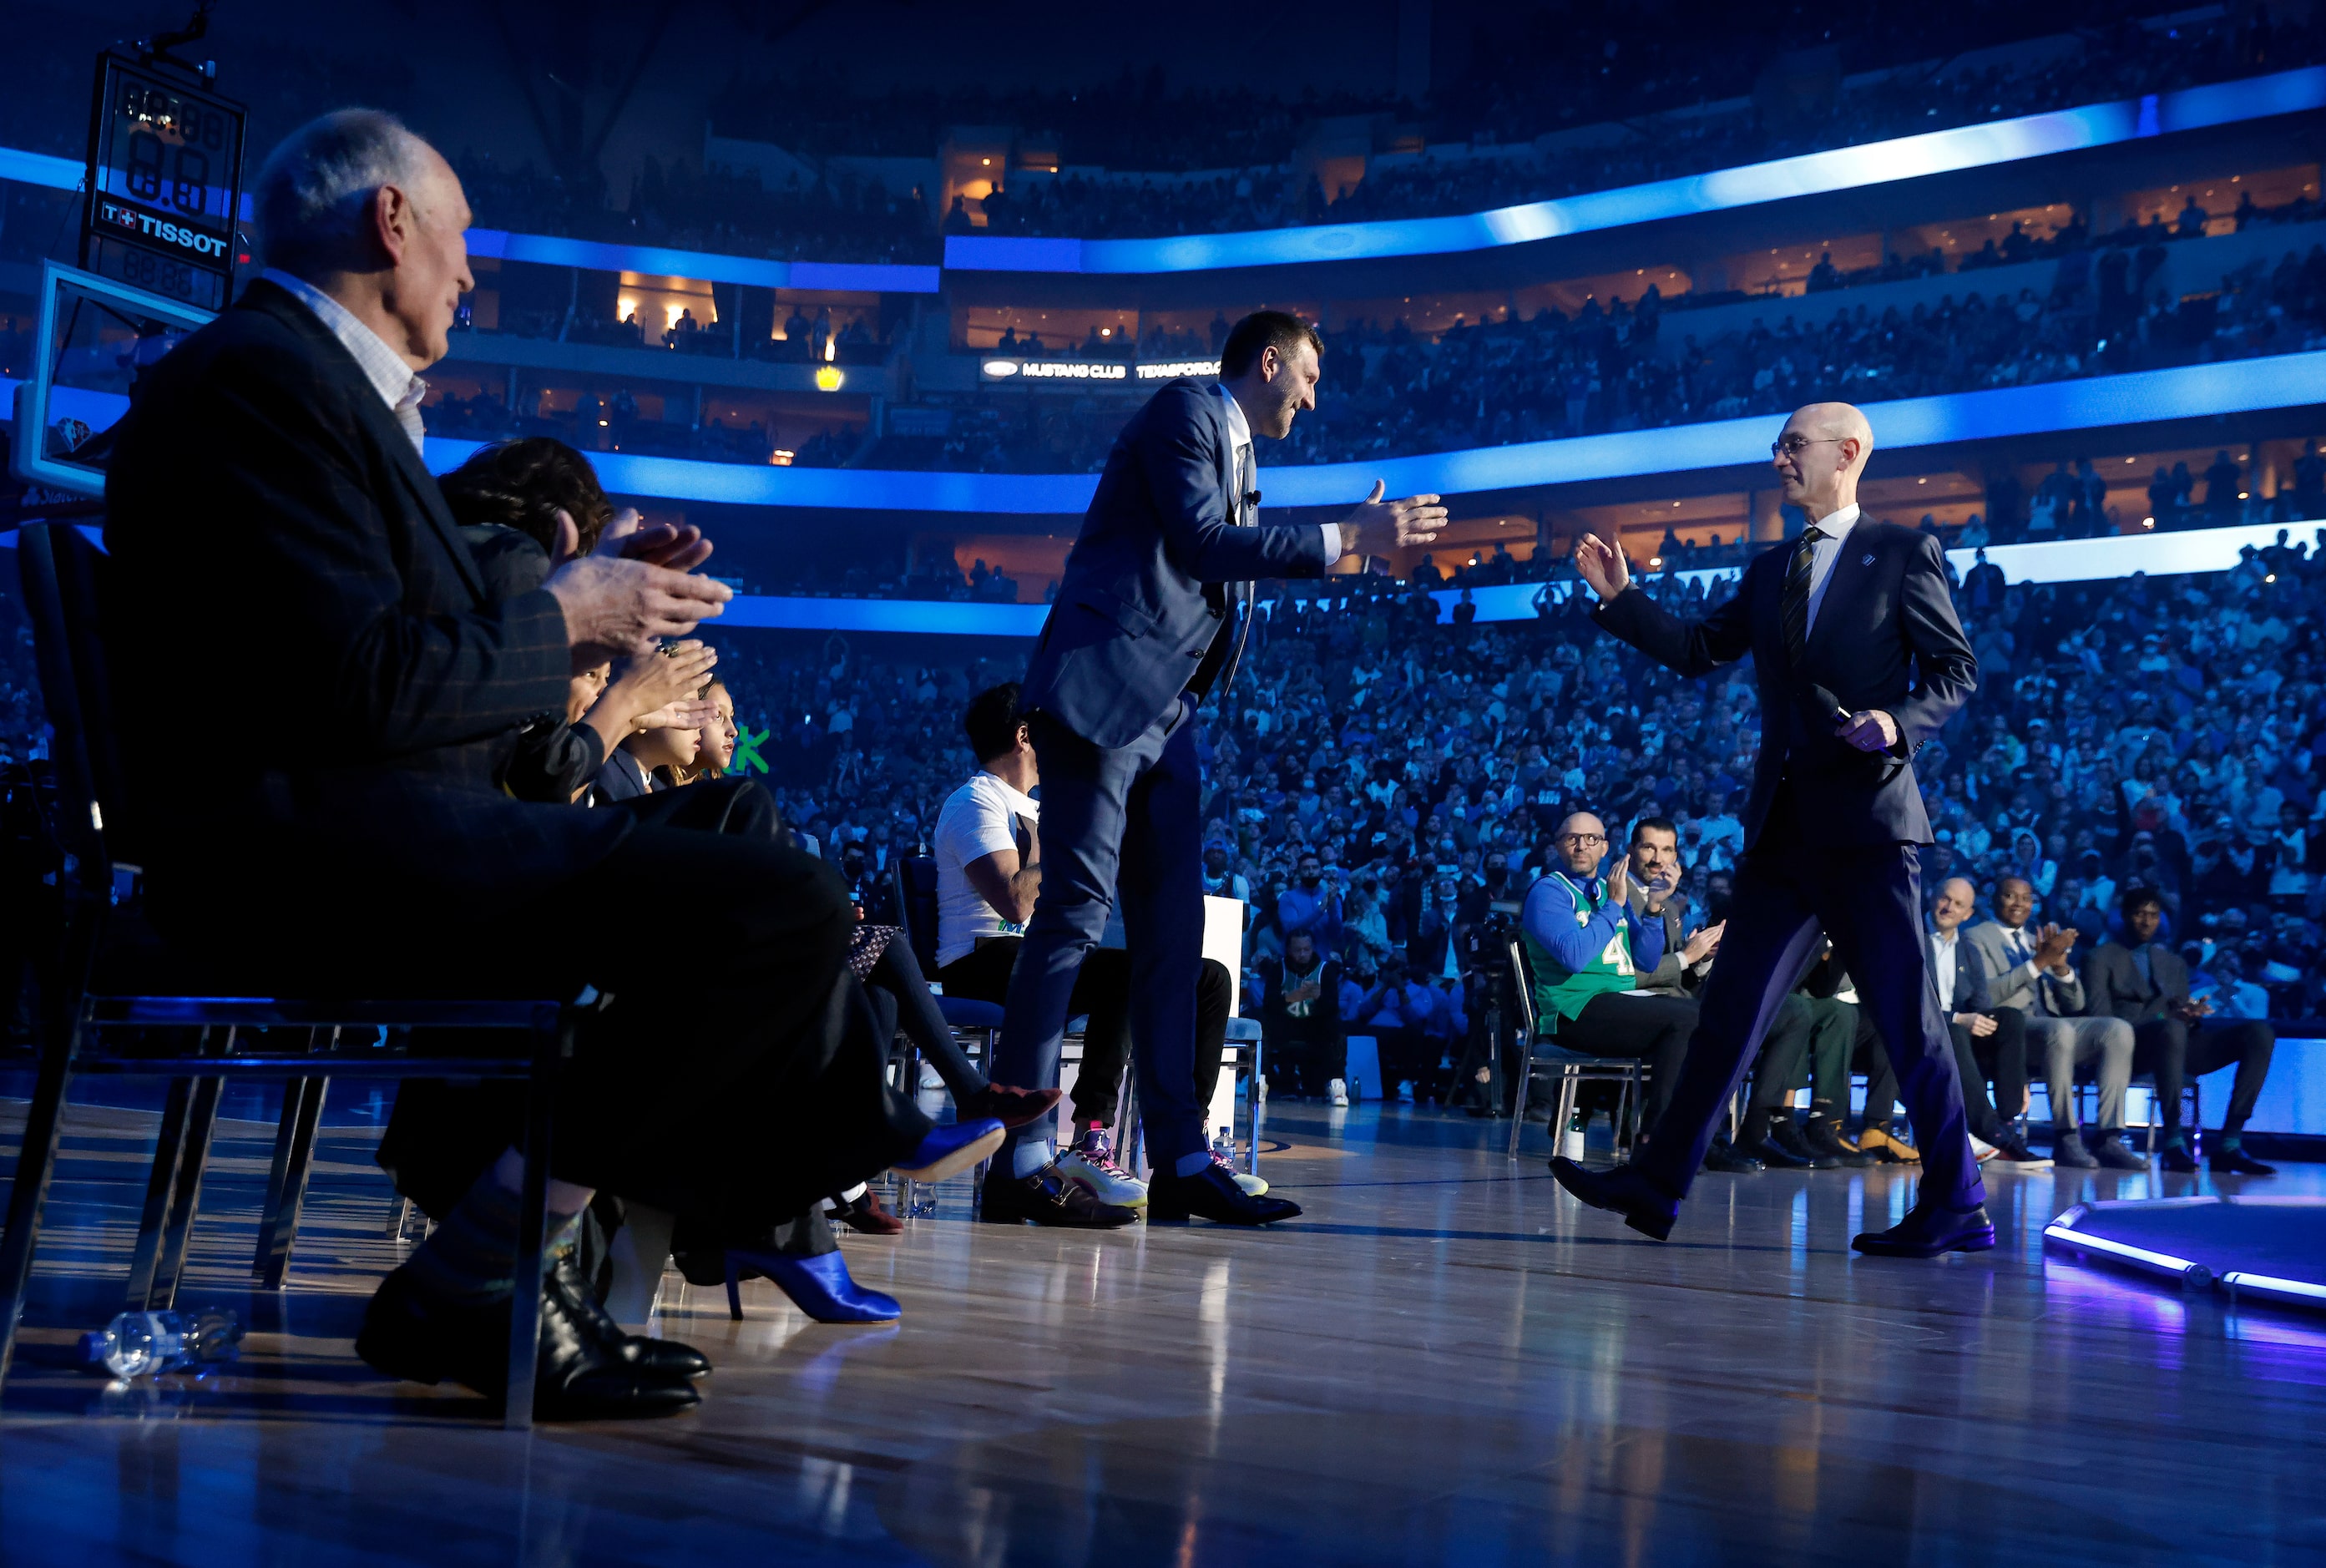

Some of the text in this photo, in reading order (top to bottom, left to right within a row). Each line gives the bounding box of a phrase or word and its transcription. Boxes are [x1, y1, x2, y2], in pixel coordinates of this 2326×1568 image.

[139, 213, 226, 257] TISSOT
[1023, 362, 1090, 378] MUSTANG
[1090, 364, 1126, 379] CLUB
[1602, 932, 1636, 976] 41
